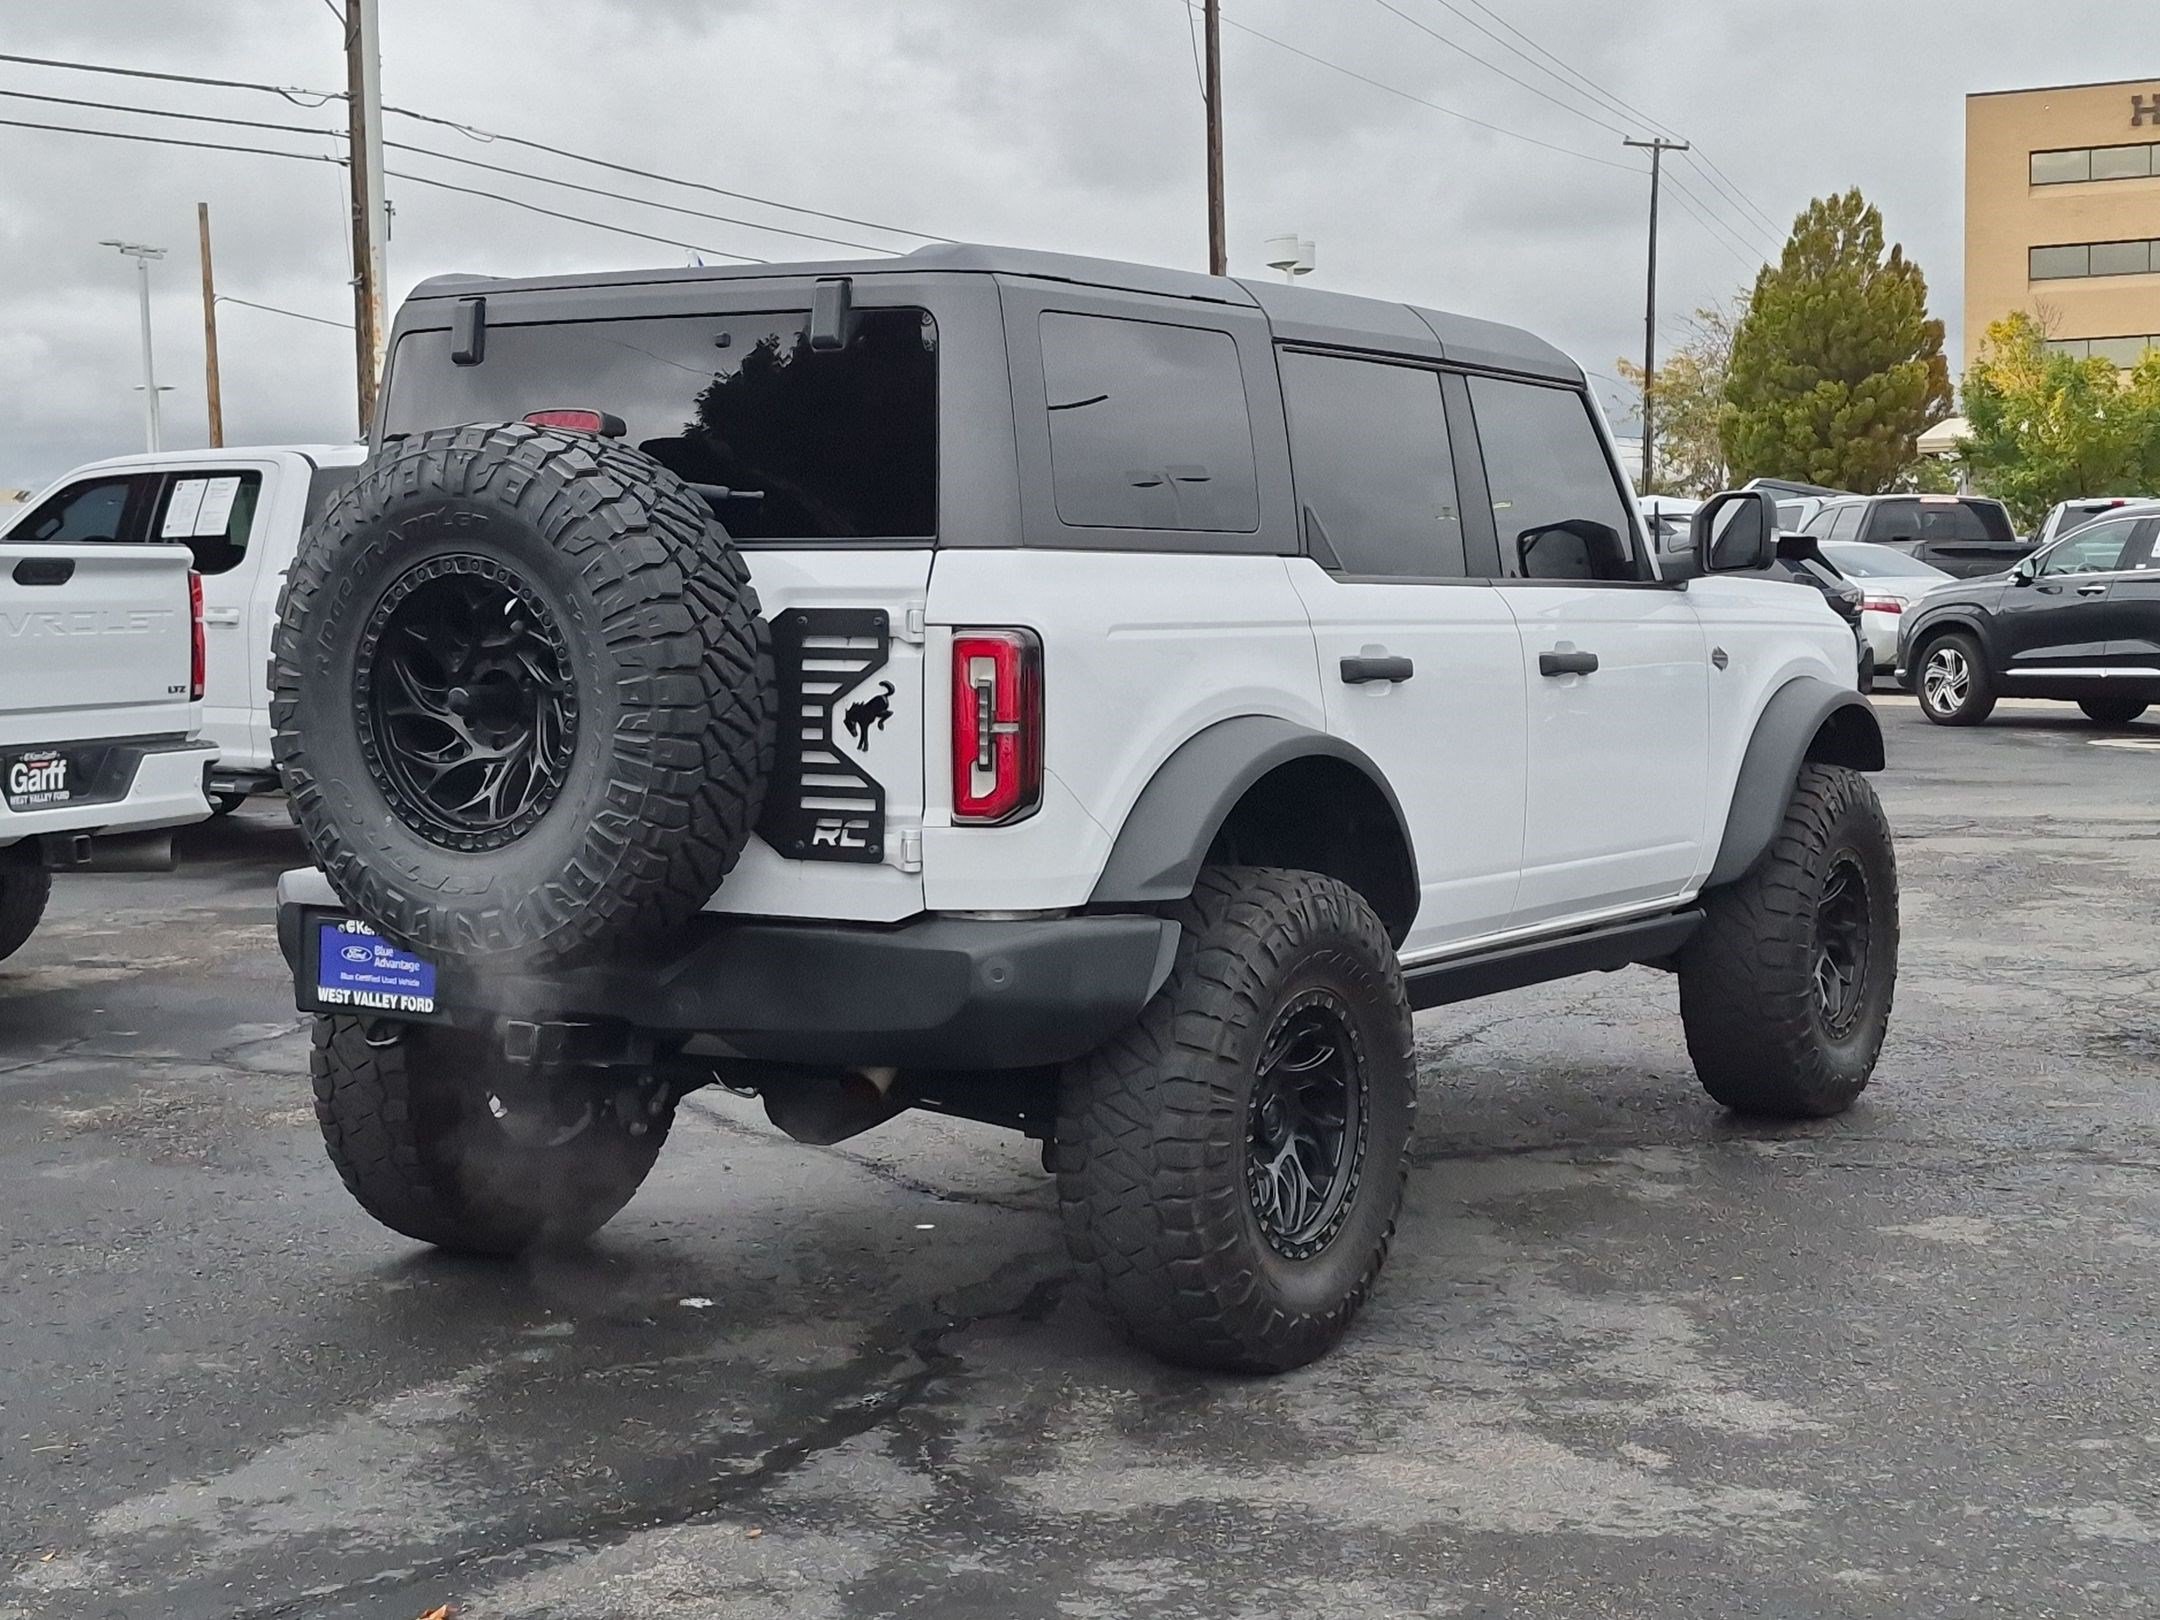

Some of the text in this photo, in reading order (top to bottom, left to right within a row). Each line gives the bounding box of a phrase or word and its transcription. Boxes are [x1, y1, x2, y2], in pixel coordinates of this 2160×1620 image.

[0, 609, 174, 638] VROLET
[168, 685, 186, 694] LTZ
[10, 759, 67, 793] Garff
[812, 817, 869, 847] RC
[374, 945, 394, 957] Blue
[374, 957, 420, 972] Advantage
[340, 972, 420, 987] Blue Certified Used Vehicle
[317, 986, 434, 1013] WEST VALLEY FORD
